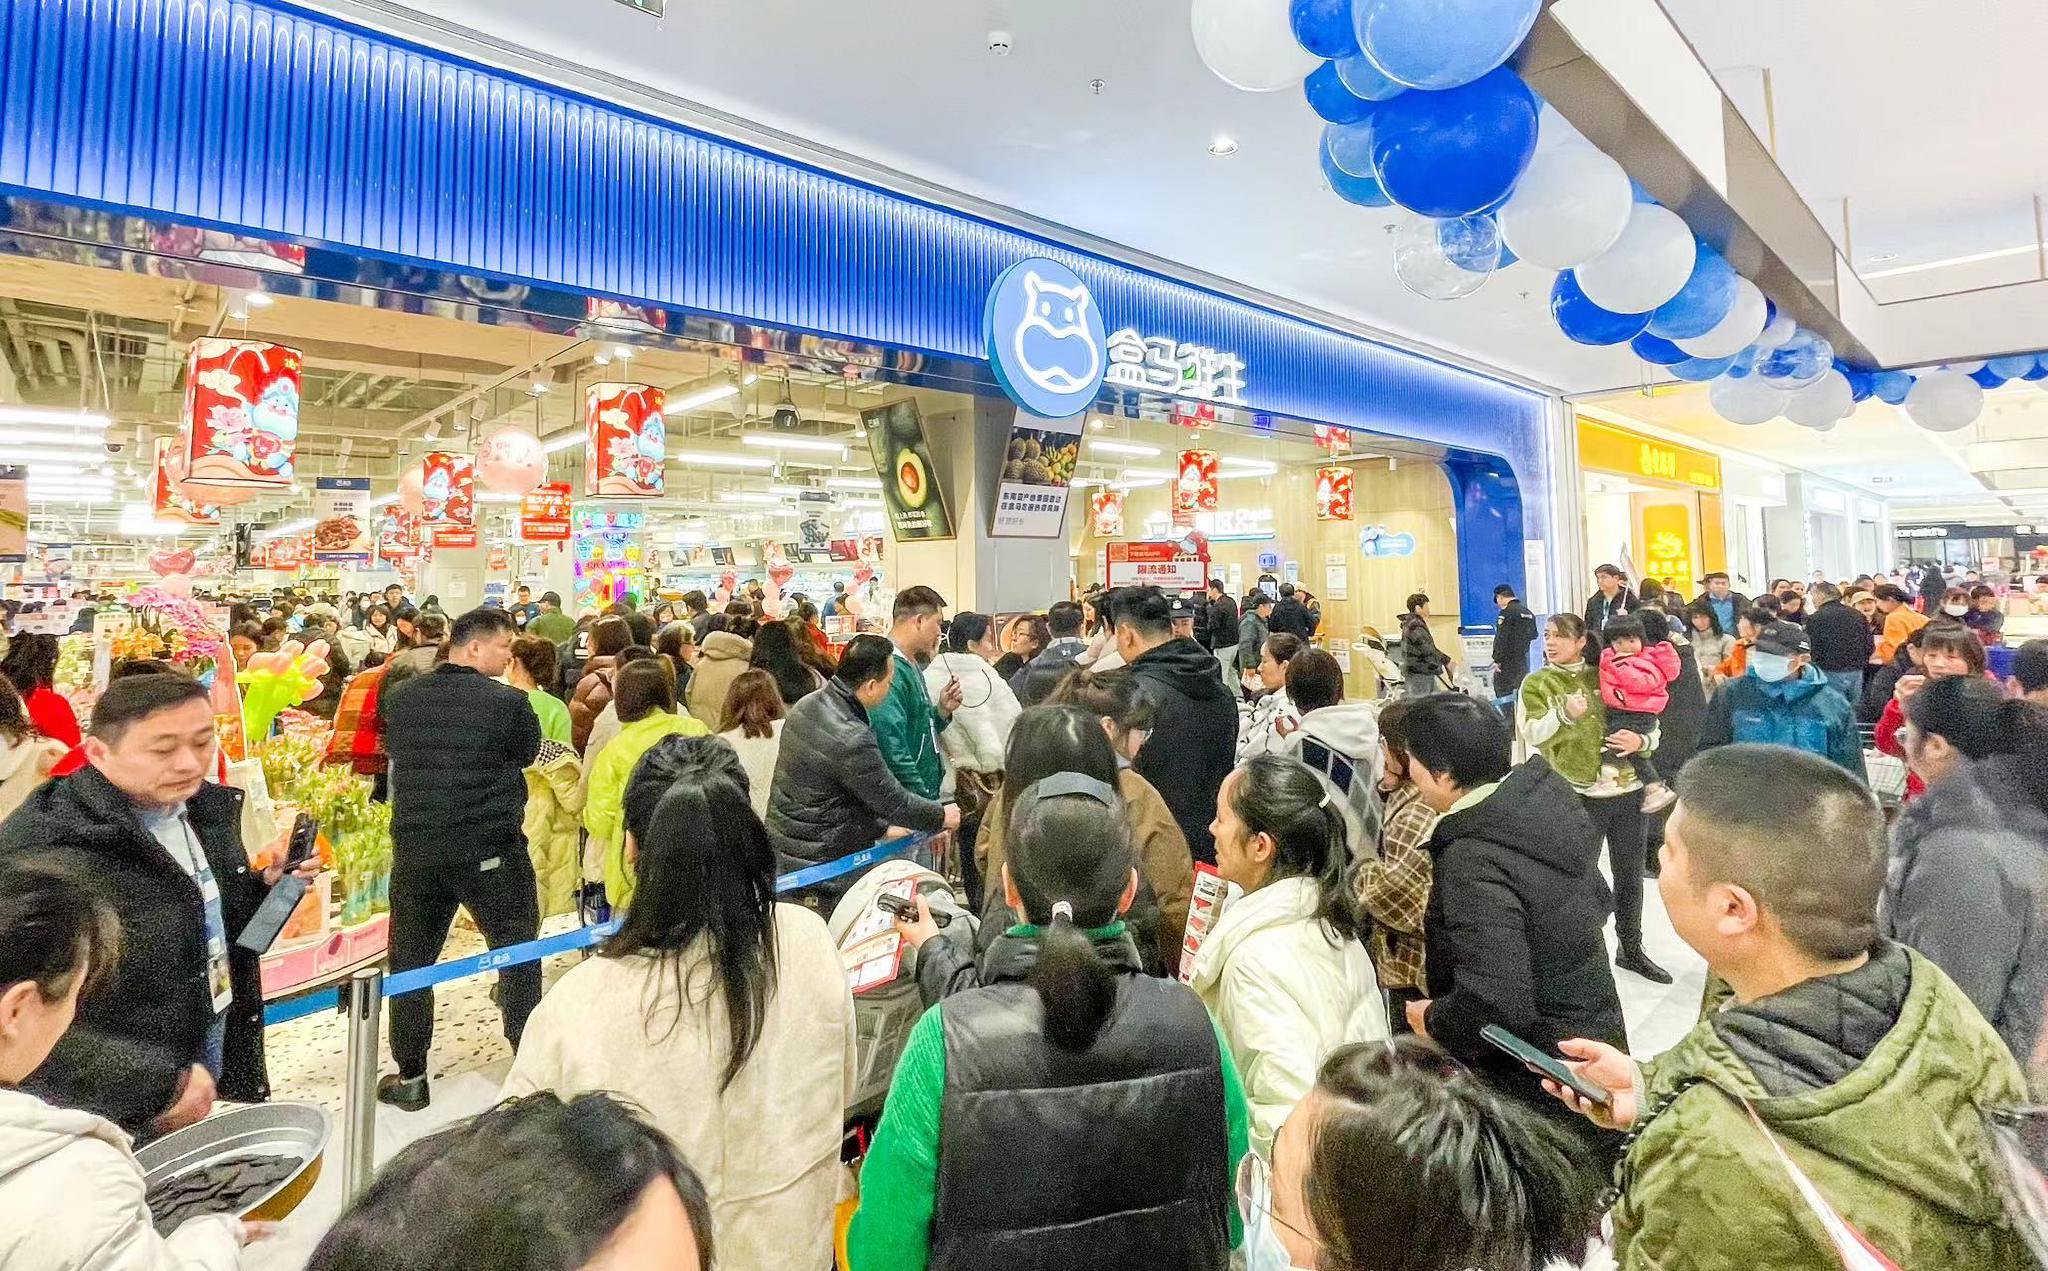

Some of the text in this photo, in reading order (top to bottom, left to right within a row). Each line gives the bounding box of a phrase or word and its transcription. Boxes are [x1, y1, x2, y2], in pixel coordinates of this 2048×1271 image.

[1103, 328, 1248, 405] 盒马鲜生
[1137, 564, 1177, 575] 限流通知
